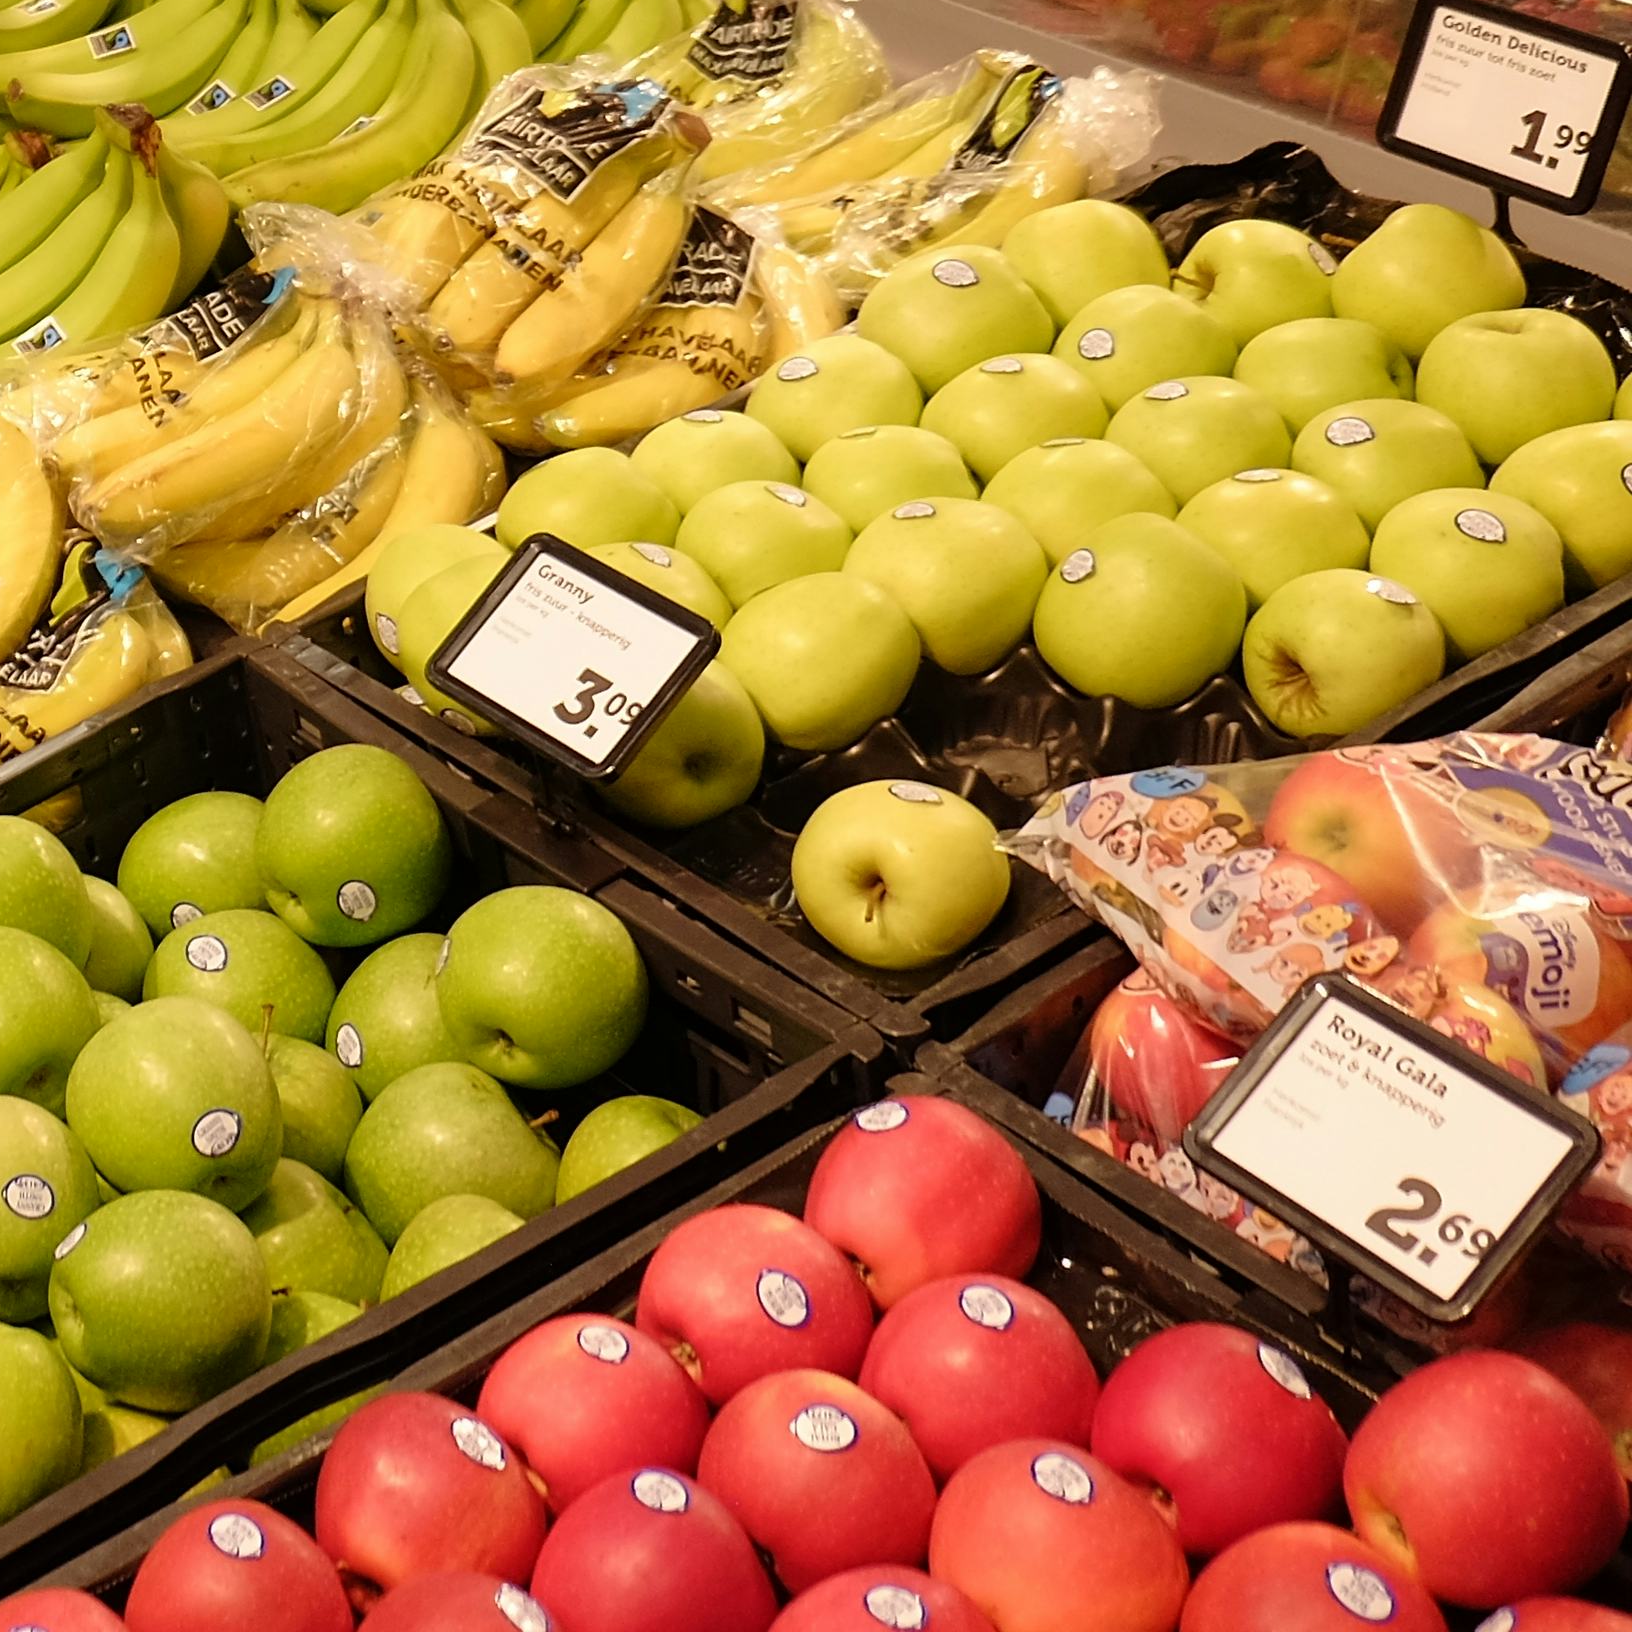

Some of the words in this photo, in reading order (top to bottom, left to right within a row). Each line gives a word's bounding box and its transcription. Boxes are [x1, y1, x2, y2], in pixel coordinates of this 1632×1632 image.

[1442, 13, 1502, 47] Golden
[1505, 35, 1589, 75] Delicious
[1457, 41, 1486, 60] zuur
[1528, 63, 1557, 83] zoet
[1510, 108, 1594, 170] 1.99
[537, 562, 596, 606] Granny
[575, 609, 633, 653] knapperig
[552, 667, 648, 739] 3.09
[1517, 911, 1571, 1010] emoji
[1309, 1037, 1346, 1066] zoet
[1362, 1067, 1449, 1130] knapperig
[1327, 1012, 1393, 1070] Royal
[1394, 1052, 1450, 1101] Gala
[1364, 1176, 1497, 1268] 2.69
